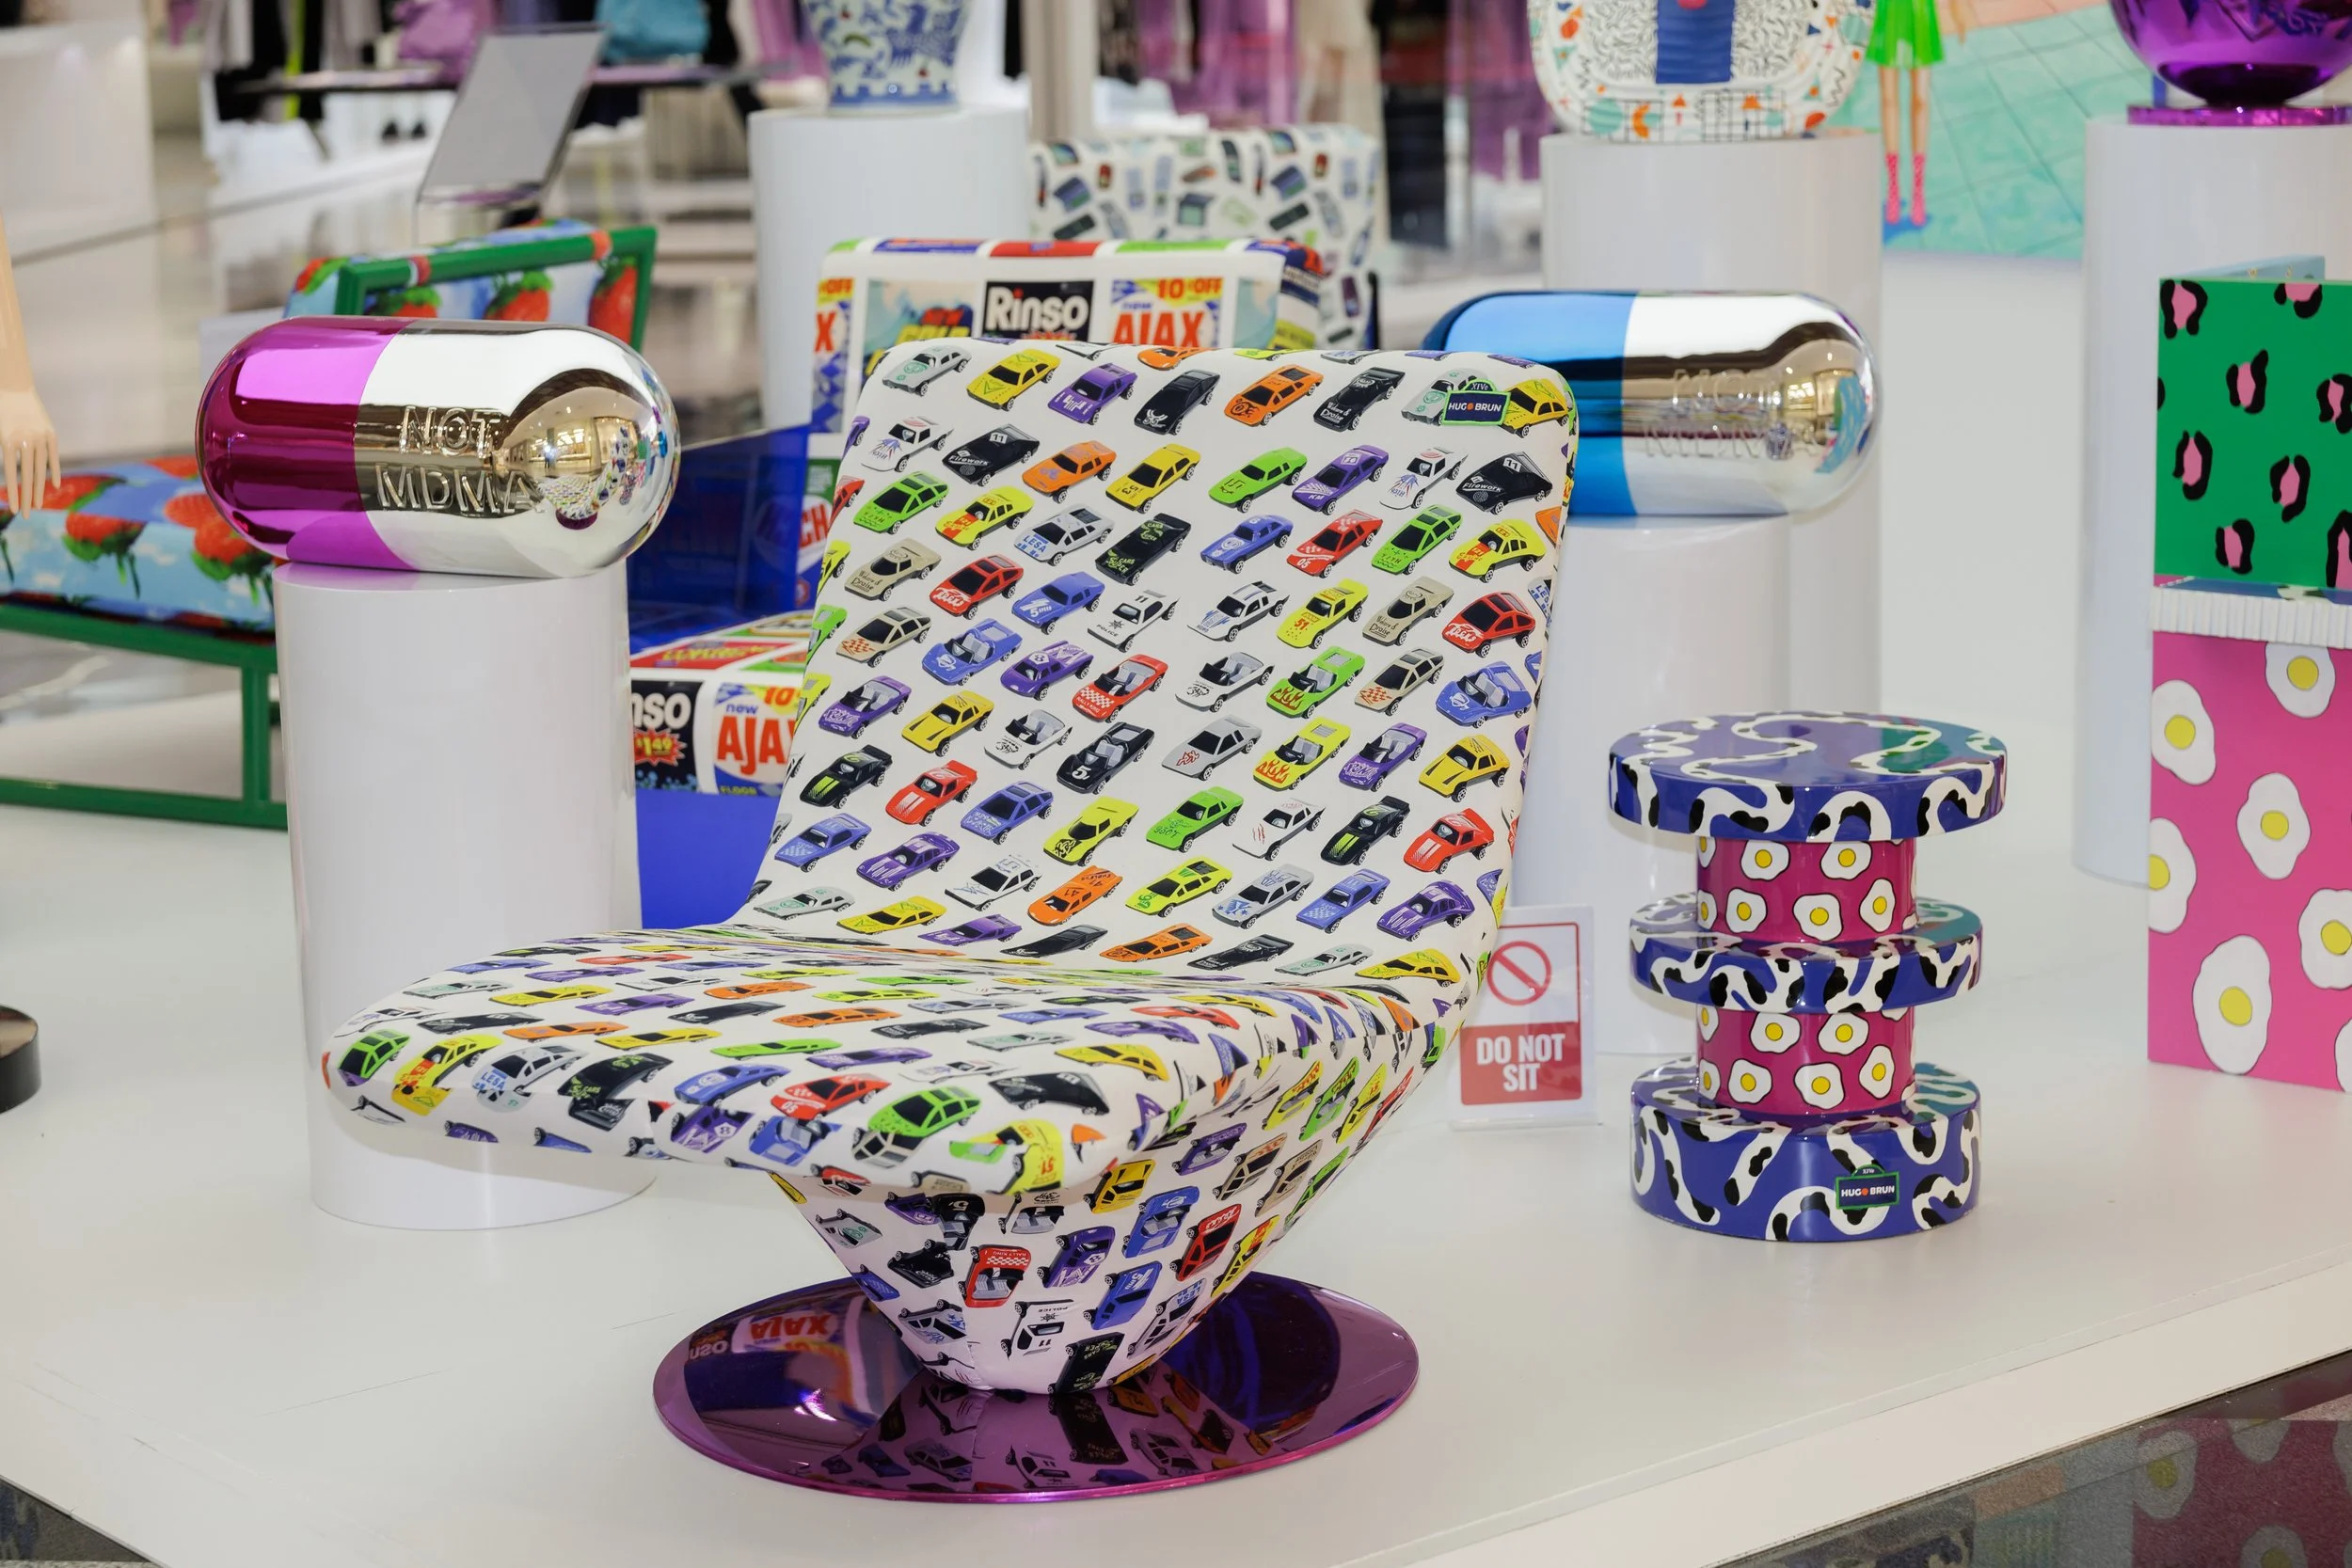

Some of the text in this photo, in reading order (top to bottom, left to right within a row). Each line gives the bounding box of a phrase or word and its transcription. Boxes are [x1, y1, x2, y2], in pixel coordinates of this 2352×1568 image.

[985, 285, 1088, 331] Rinso
[1672, 368, 1776, 412] NOT
[1474, 403, 1502, 412] BRUN
[400, 404, 501, 459] NOT
[948, 453, 989, 467] Firework
[374, 463, 546, 518] MDMA
[1462, 481, 1503, 493] Firework
[1023, 534, 1047, 553] LESA
[1097, 624, 1119, 637] POLICE
[631, 692, 691, 730] nso
[726, 704, 758, 715] new
[1476, 1033, 1565, 1065] DO NOT
[481, 1070, 506, 1090] LESA
[1502, 1063, 1541, 1092] SIT
[1869, 1185, 1895, 1195] BRUN
